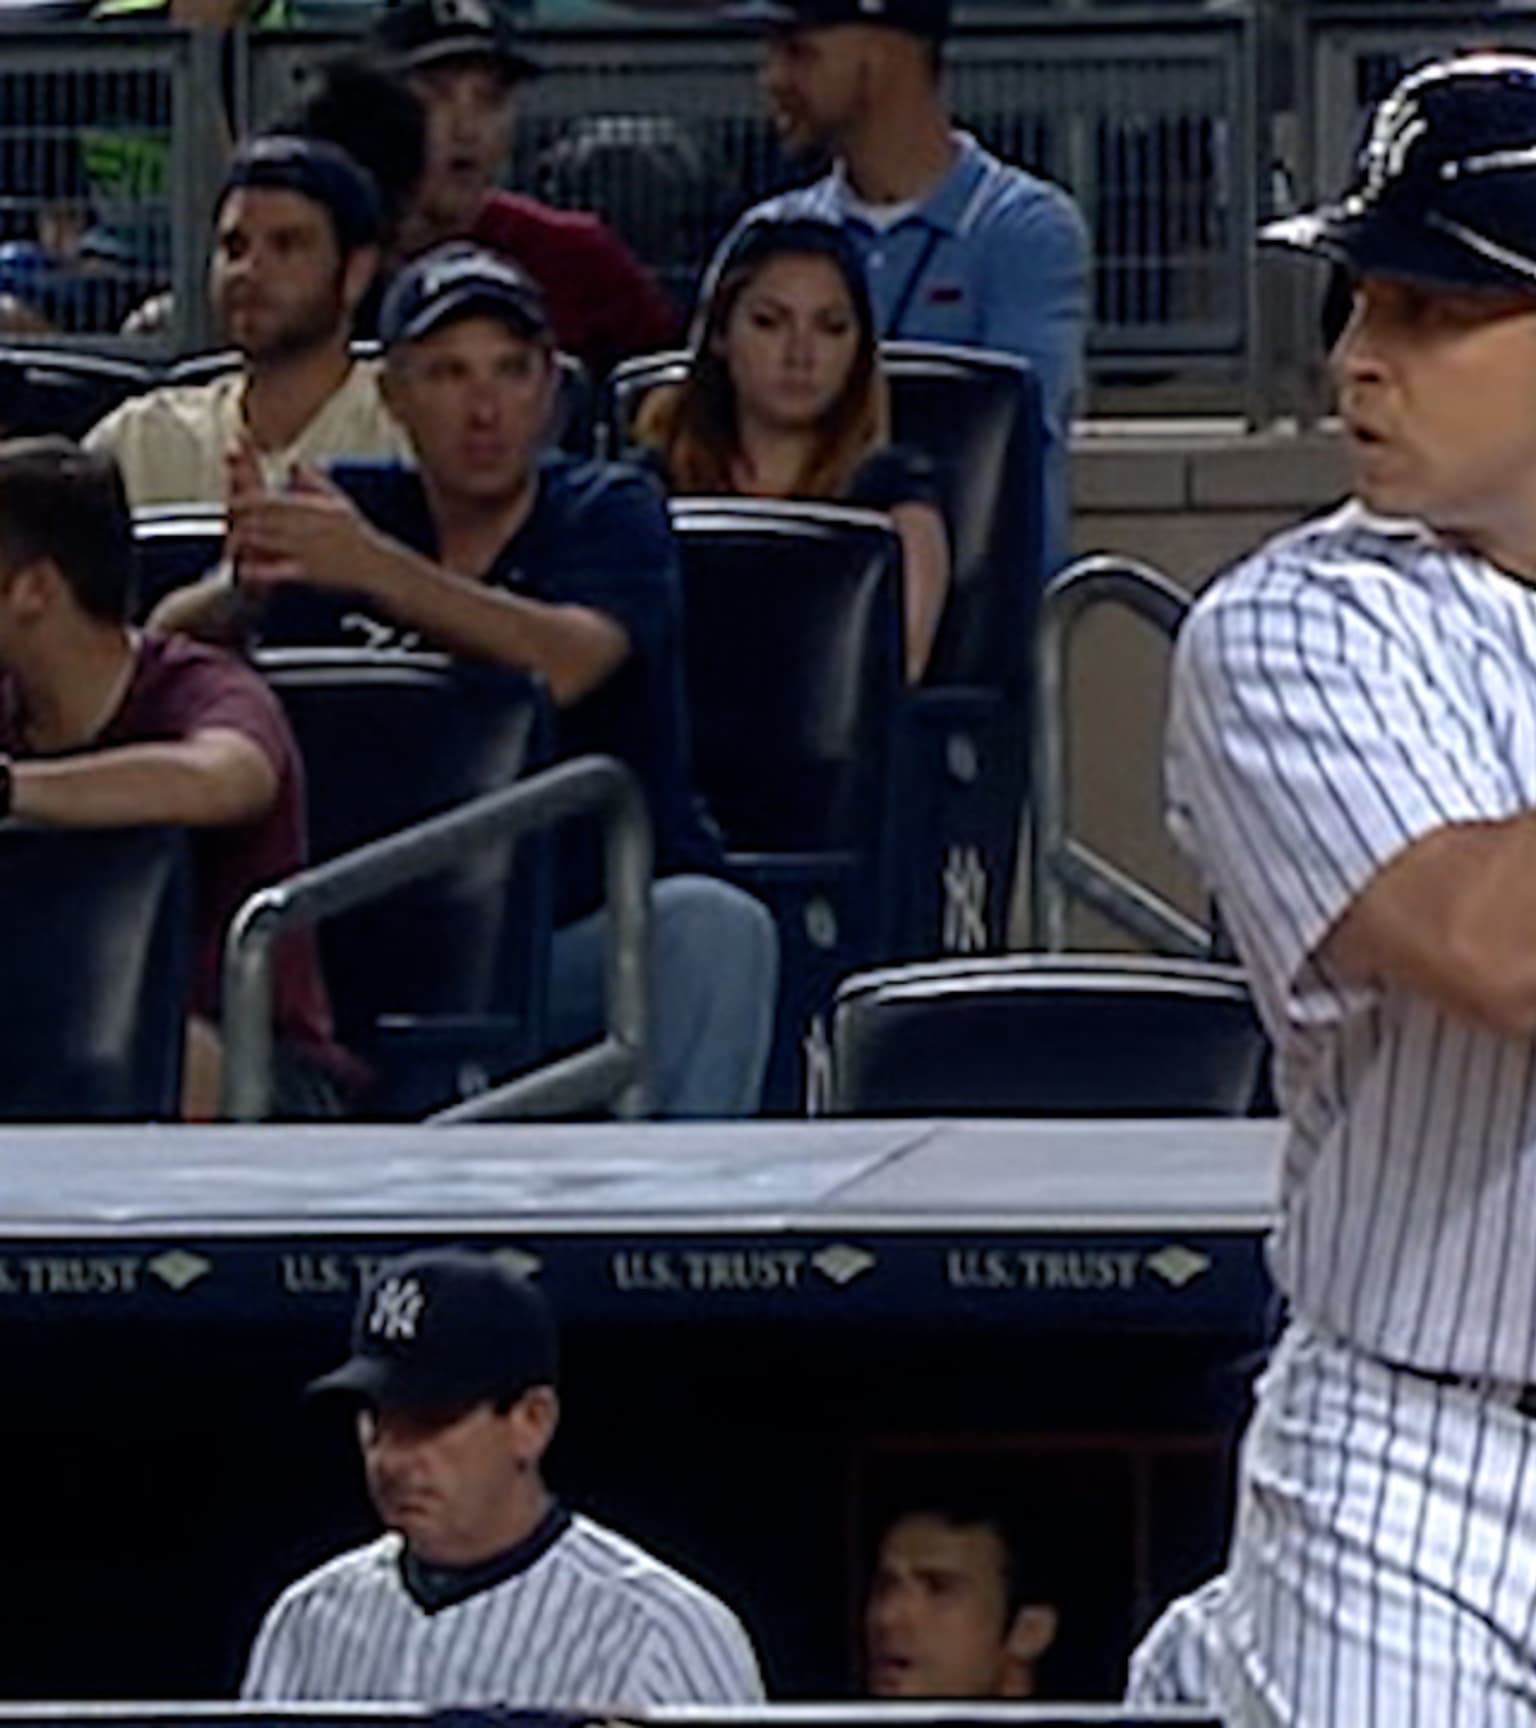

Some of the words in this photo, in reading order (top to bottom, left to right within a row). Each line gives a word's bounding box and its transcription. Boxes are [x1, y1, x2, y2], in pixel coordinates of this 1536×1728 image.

[22, 1256, 139, 1293] TRUST
[283, 1254, 350, 1293] U.S.
[613, 1252, 681, 1291] U.S.
[684, 1251, 804, 1290] TRUST
[948, 1251, 1016, 1288] U.S.
[1018, 1251, 1138, 1288] TRUST
[370, 1279, 424, 1340] NY
